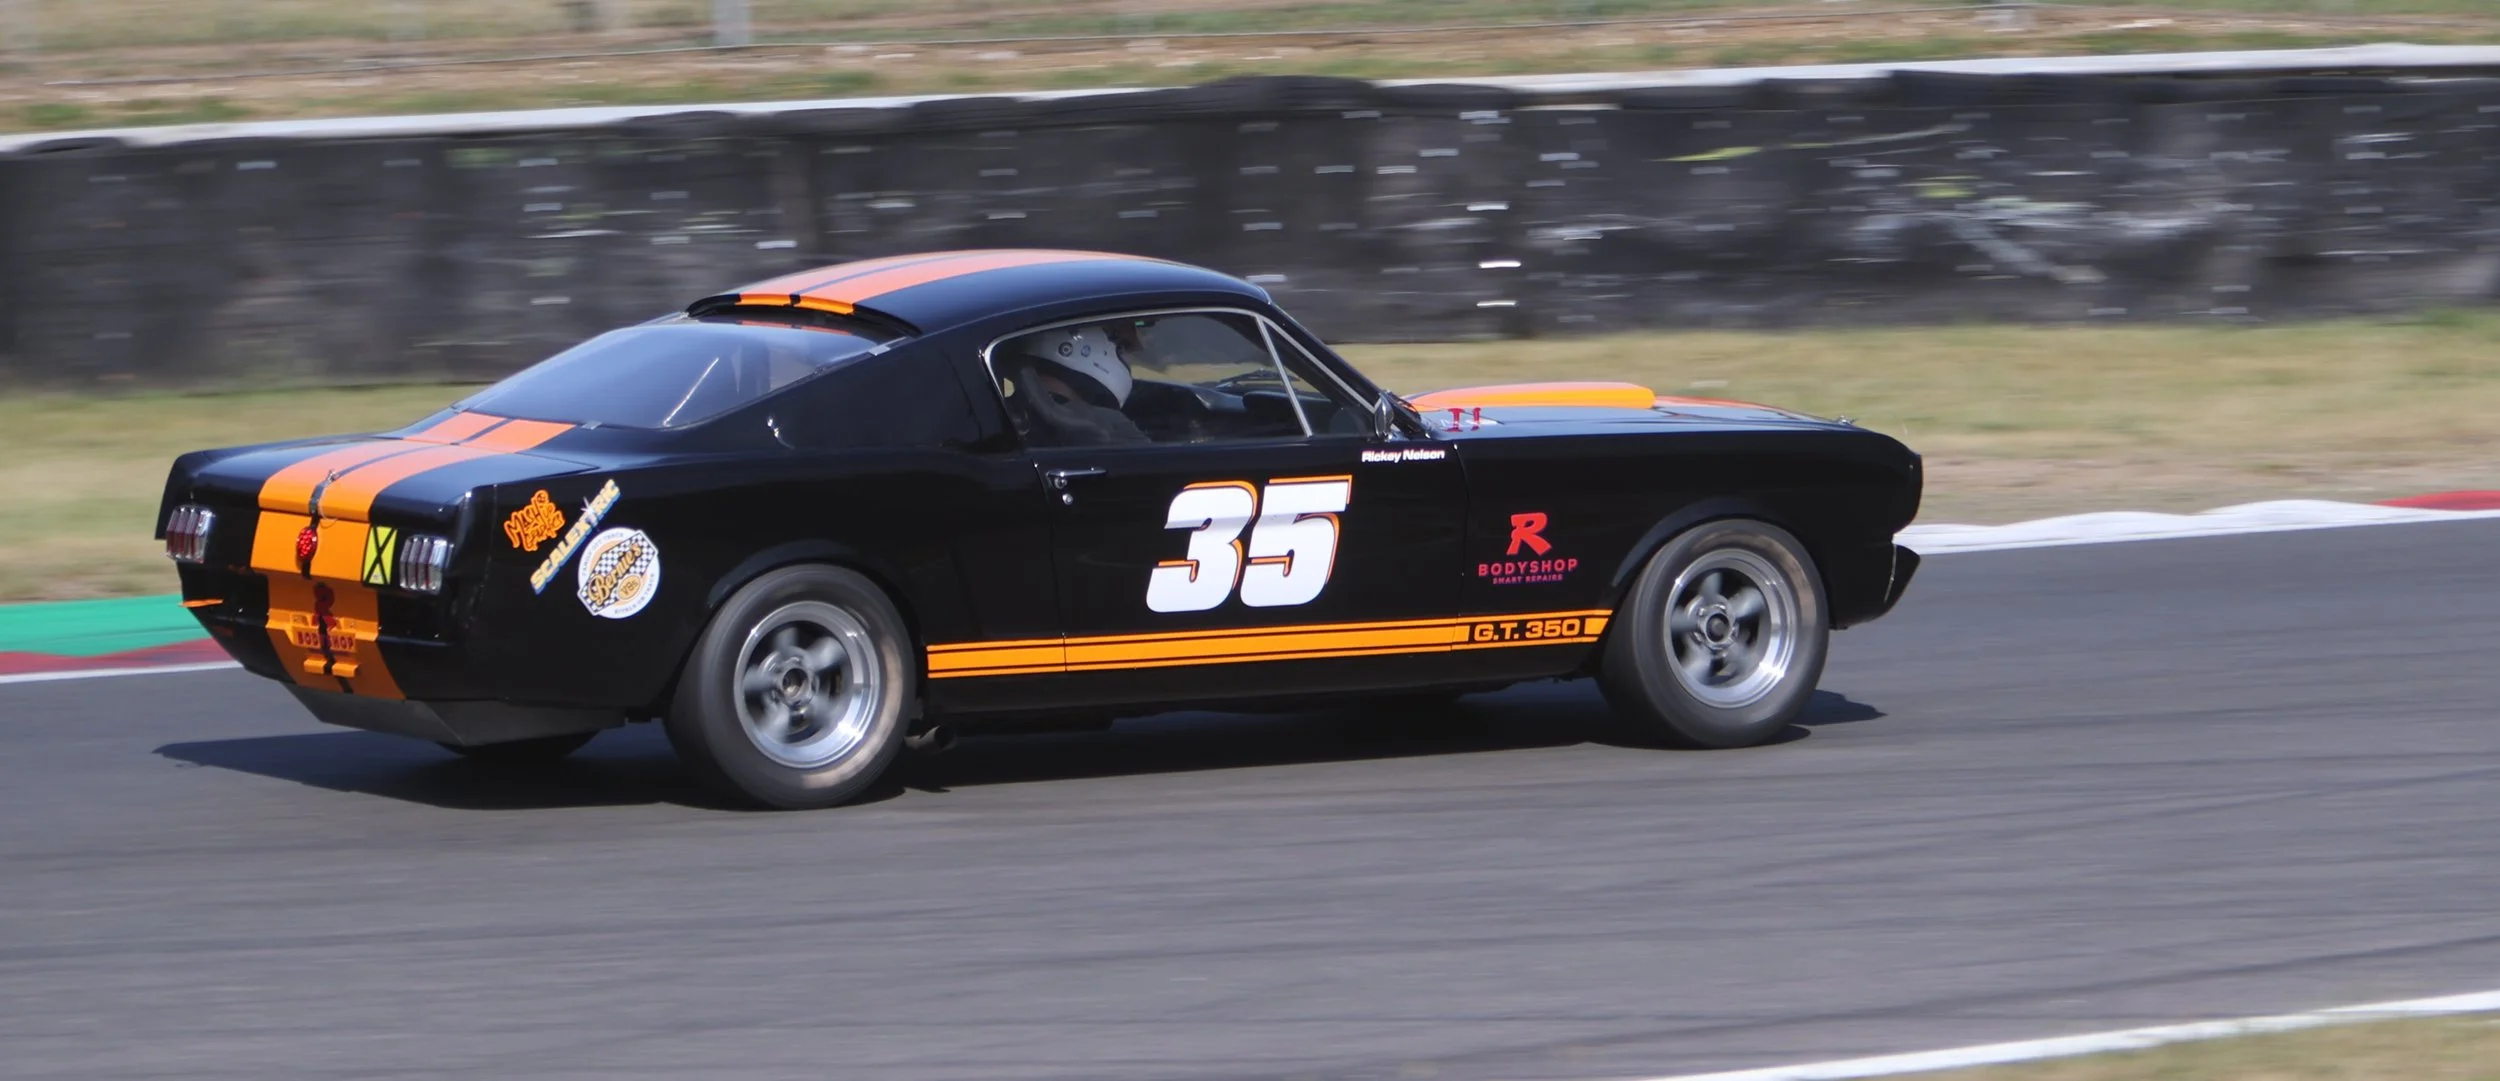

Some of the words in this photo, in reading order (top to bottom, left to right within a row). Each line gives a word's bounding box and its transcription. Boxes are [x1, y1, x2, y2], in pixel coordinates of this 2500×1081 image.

[1362, 451, 1400, 463] Rickey
[1403, 449, 1445, 460] Nelson
[530, 479, 621, 594] SCALEXTRIC
[1146, 475, 1352, 612] 35
[1506, 512, 1552, 556] R
[588, 543, 642, 605] Bernie's
[1478, 559, 1578, 576] BODYSHOP
[1493, 576, 1522, 585] SMART
[1525, 574, 1563, 583] REPAIRS
[1474, 622, 1520, 642] G.T.
[1525, 619, 1581, 638] 350
